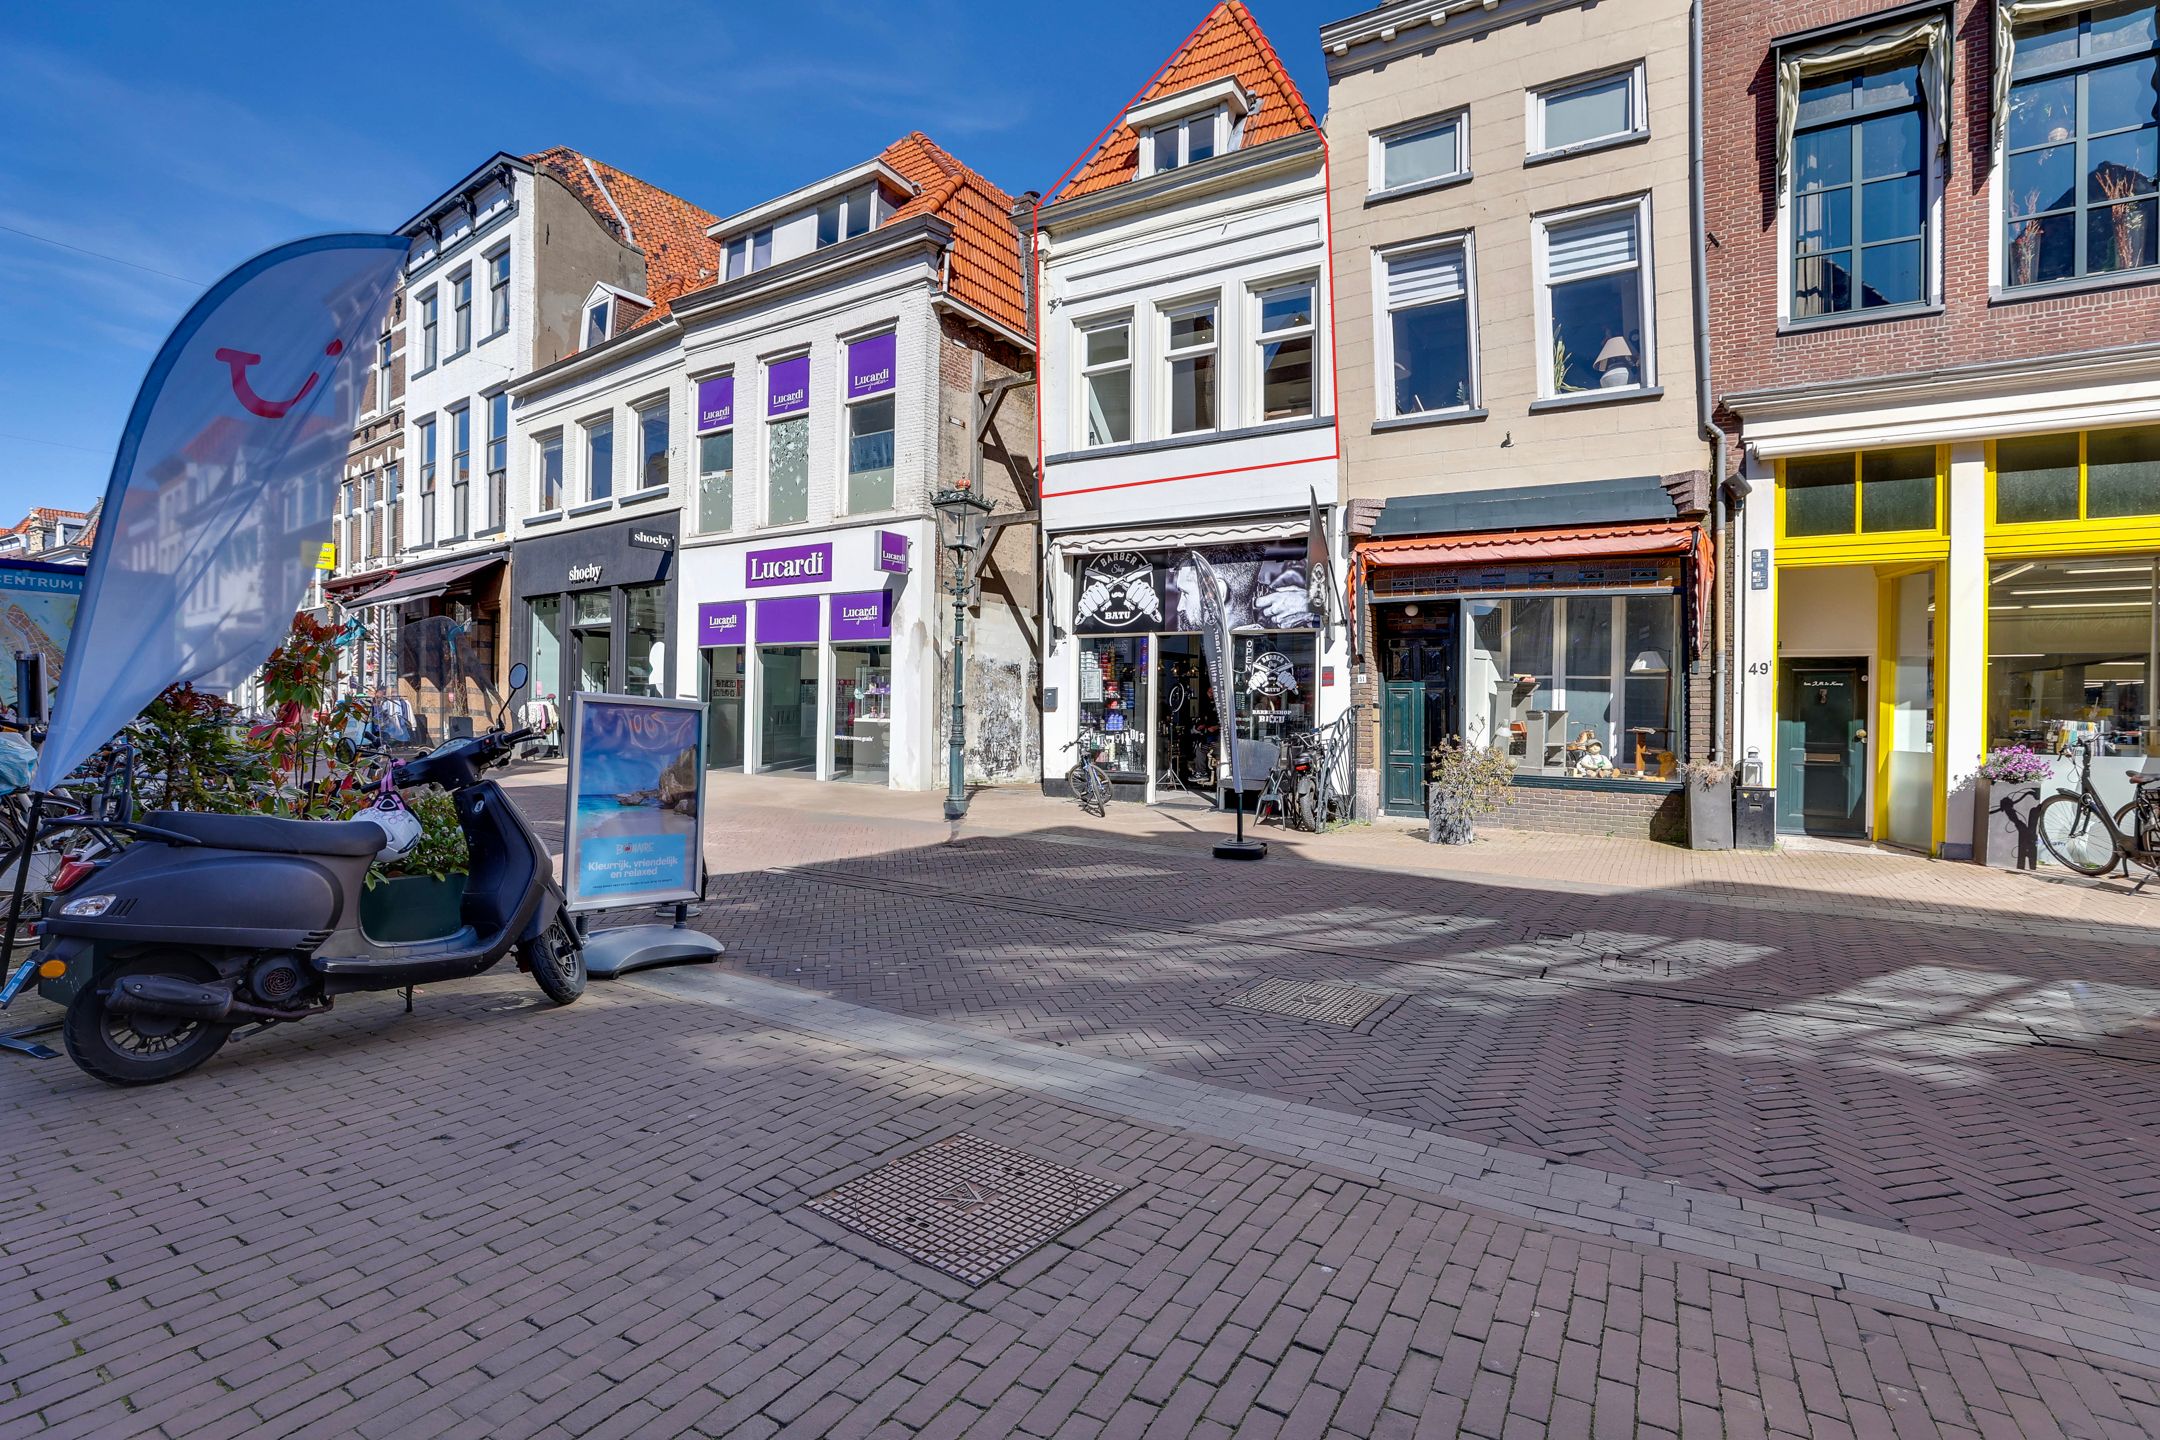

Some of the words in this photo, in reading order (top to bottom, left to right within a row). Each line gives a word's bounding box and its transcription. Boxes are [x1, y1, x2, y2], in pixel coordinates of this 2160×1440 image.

[855, 368, 889, 386] Lucardi
[773, 389, 803, 405] Lucardi
[703, 406, 730, 420] Lucardi
[634, 532, 671, 547] shoeby
[882, 550, 906, 562] Lucardi
[1100, 552, 1137, 567] BARBER
[568, 563, 602, 581] shoeby
[751, 552, 824, 580] Lucardi
[0, 574, 73, 590] ENTRUM
[843, 605, 878, 617] Lucardi
[1105, 611, 1131, 620] BATU
[709, 614, 737, 625] Lucardi
[588, 859, 632, 872] Kleurrijk,
[633, 856, 679, 867] vriendelijk
[624, 867, 658, 878] relaxed
